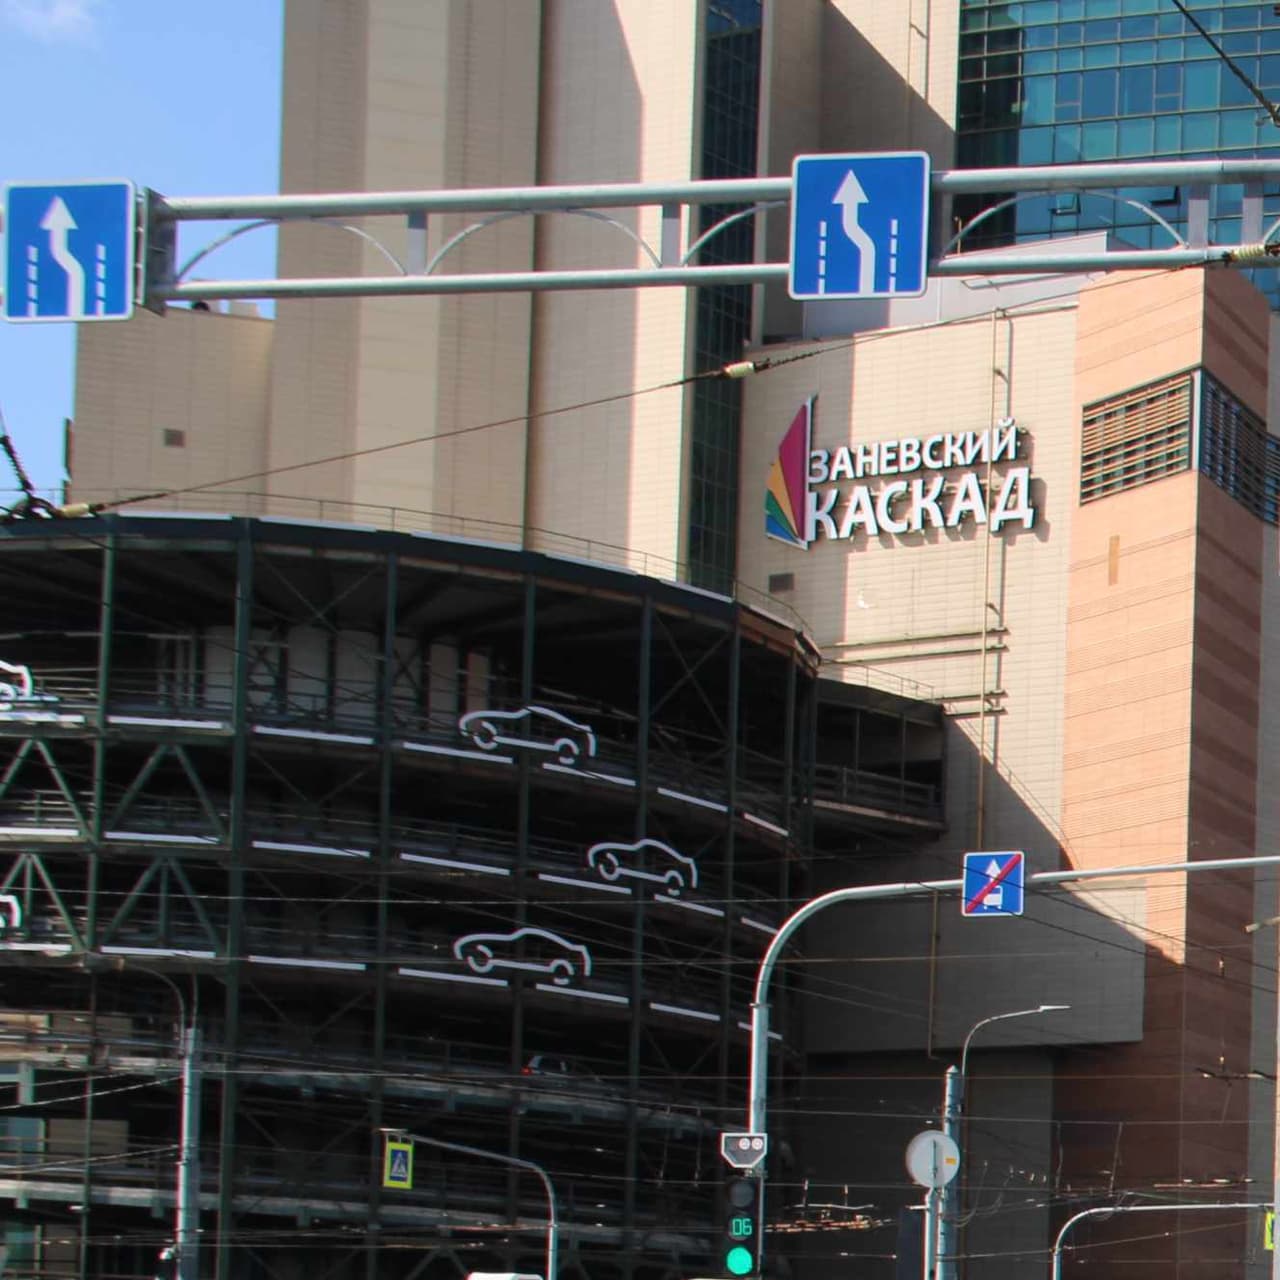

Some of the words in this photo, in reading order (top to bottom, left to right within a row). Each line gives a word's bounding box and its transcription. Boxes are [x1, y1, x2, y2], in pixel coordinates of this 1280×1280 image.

[808, 416, 1018, 484] ЗАНЕВСКИЙ
[806, 466, 1034, 542] КАСКАД
[732, 1217, 753, 1236] 06
